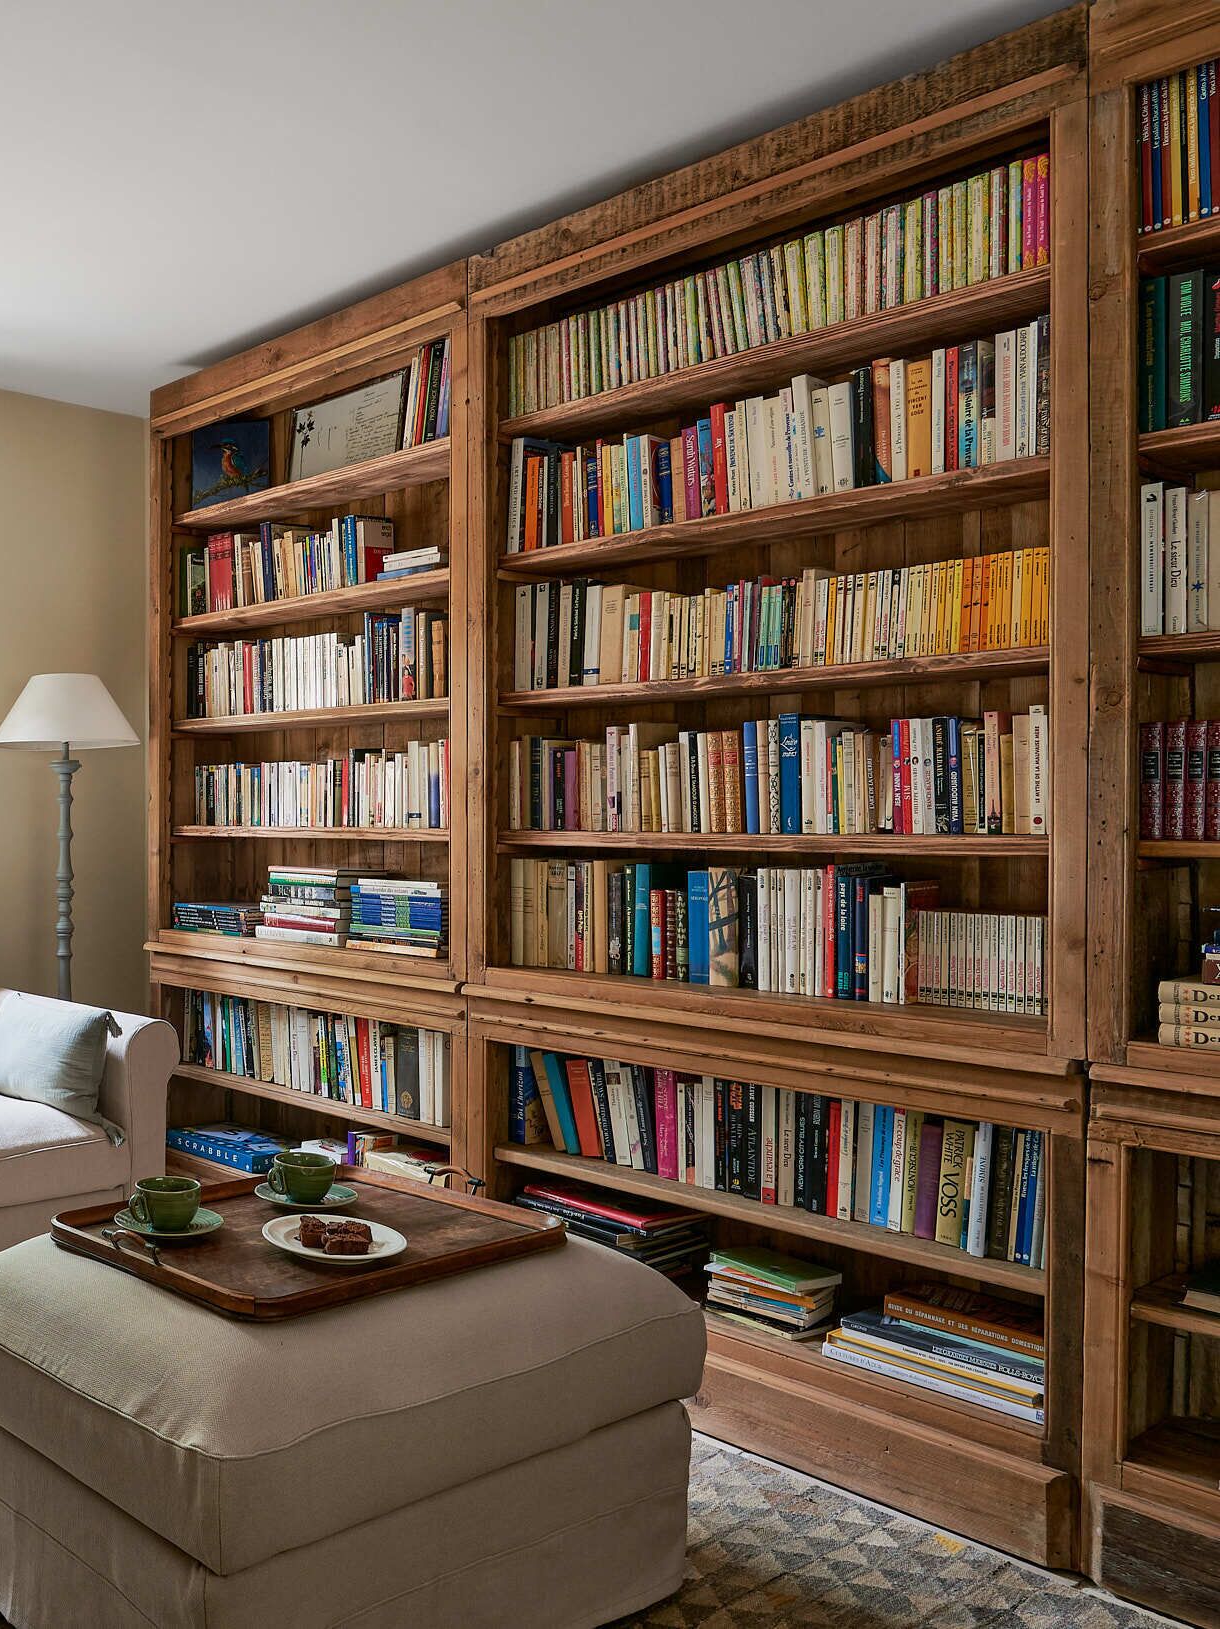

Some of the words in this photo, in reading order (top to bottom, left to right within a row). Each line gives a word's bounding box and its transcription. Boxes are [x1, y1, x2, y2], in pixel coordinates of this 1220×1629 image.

[1180, 280, 1192, 294] TOM
[1180, 295, 1192, 317] WOLFE
[1179, 336, 1192, 371] CHARLOTTE
[964, 385, 974, 419] Histoire
[1179, 371, 1193, 403] SIMMONS
[799, 410, 808, 446] ALLEMANDE
[686, 434, 695, 459] Sarah
[687, 459, 697, 488] Waters
[1170, 551, 1181, 569] sieur
[1169, 569, 1182, 588] Dieu
[935, 747, 943, 777] MALRAUX
[950, 771, 958, 803] AUDOUARD
[838, 883, 847, 898] pays
[839, 916, 848, 931] loire
[516, 1071, 524, 1106] l'horizon
[893, 1129, 902, 1149] coup
[897, 1119, 904, 1128] Le
[177, 1137, 239, 1163] SCRABBLE
[746, 1127, 757, 1184] ATLANTIDE
[764, 1137, 773, 1172] revanche
[943, 1132, 955, 1164] WHITE
[952, 1129, 965, 1169] PATRICK
[764, 1172, 773, 1184] La
[907, 1145, 917, 1193] MONTSÉGUR
[977, 1155, 987, 1184] SIMONE
[939, 1172, 960, 1218] VOSS
[888, 1303, 903, 1312] GUIDE
[915, 1310, 945, 1325] DÉPANNAGE
[947, 1319, 955, 1327] ET
[957, 1323, 968, 1331] DES
[971, 1326, 1009, 1343] RÉPARATIONS
[940, 1348, 969, 1361] GRANDES
[969, 1356, 997, 1370] MARQUES
[998, 1364, 1044, 1383] ROLLS-ROYCE
